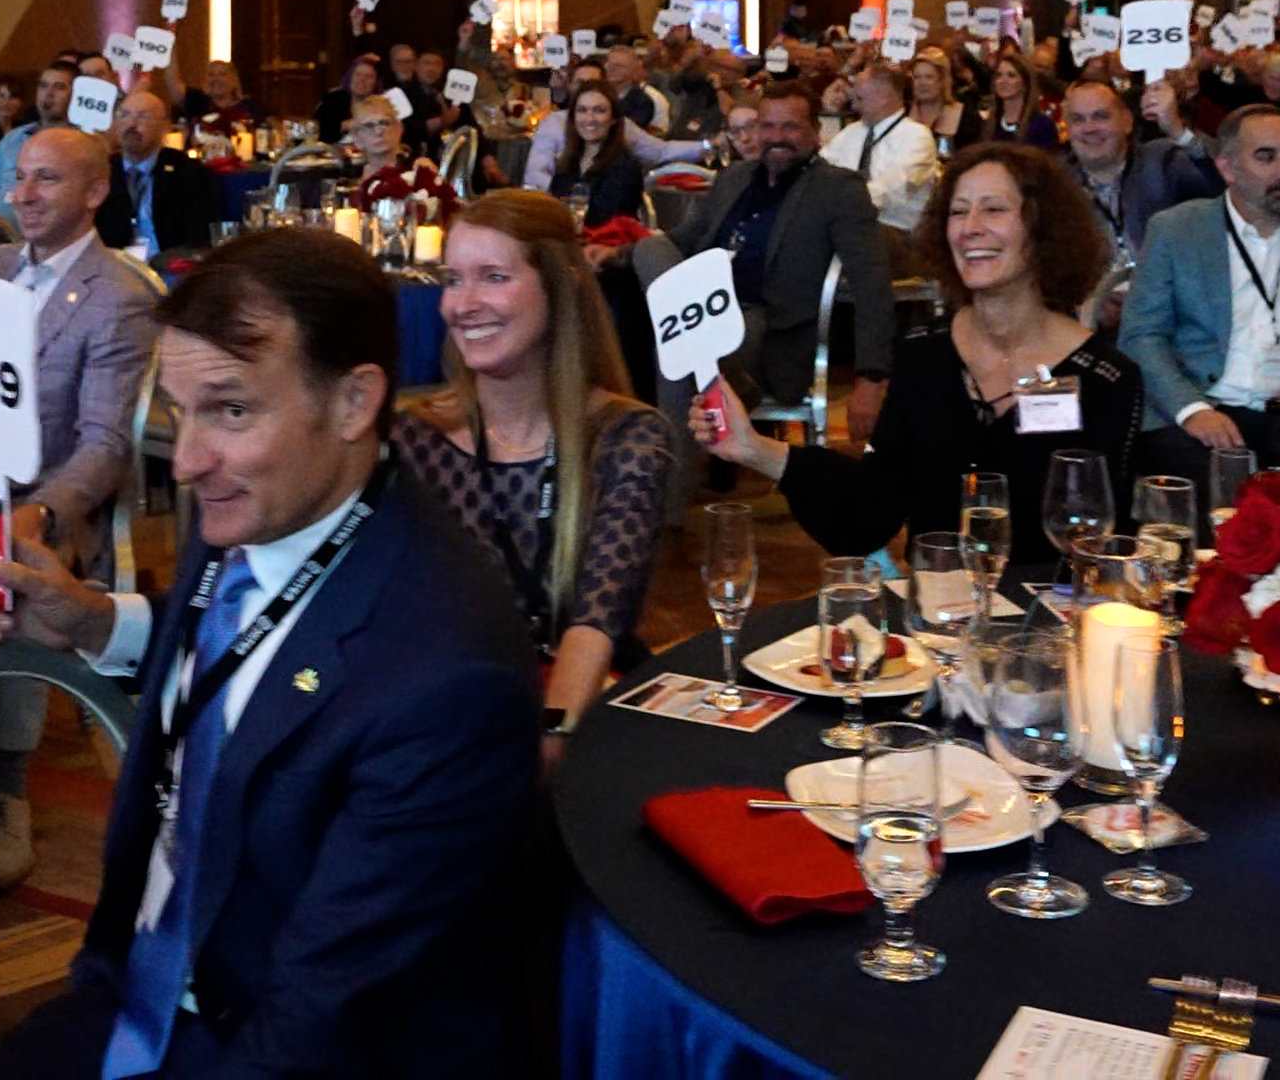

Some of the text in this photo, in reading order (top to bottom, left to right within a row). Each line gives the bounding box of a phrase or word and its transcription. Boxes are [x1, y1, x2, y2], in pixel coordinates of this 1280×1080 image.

[1128, 27, 1183, 44] 236
[77, 96, 108, 113] 168
[659, 289, 730, 344] 290
